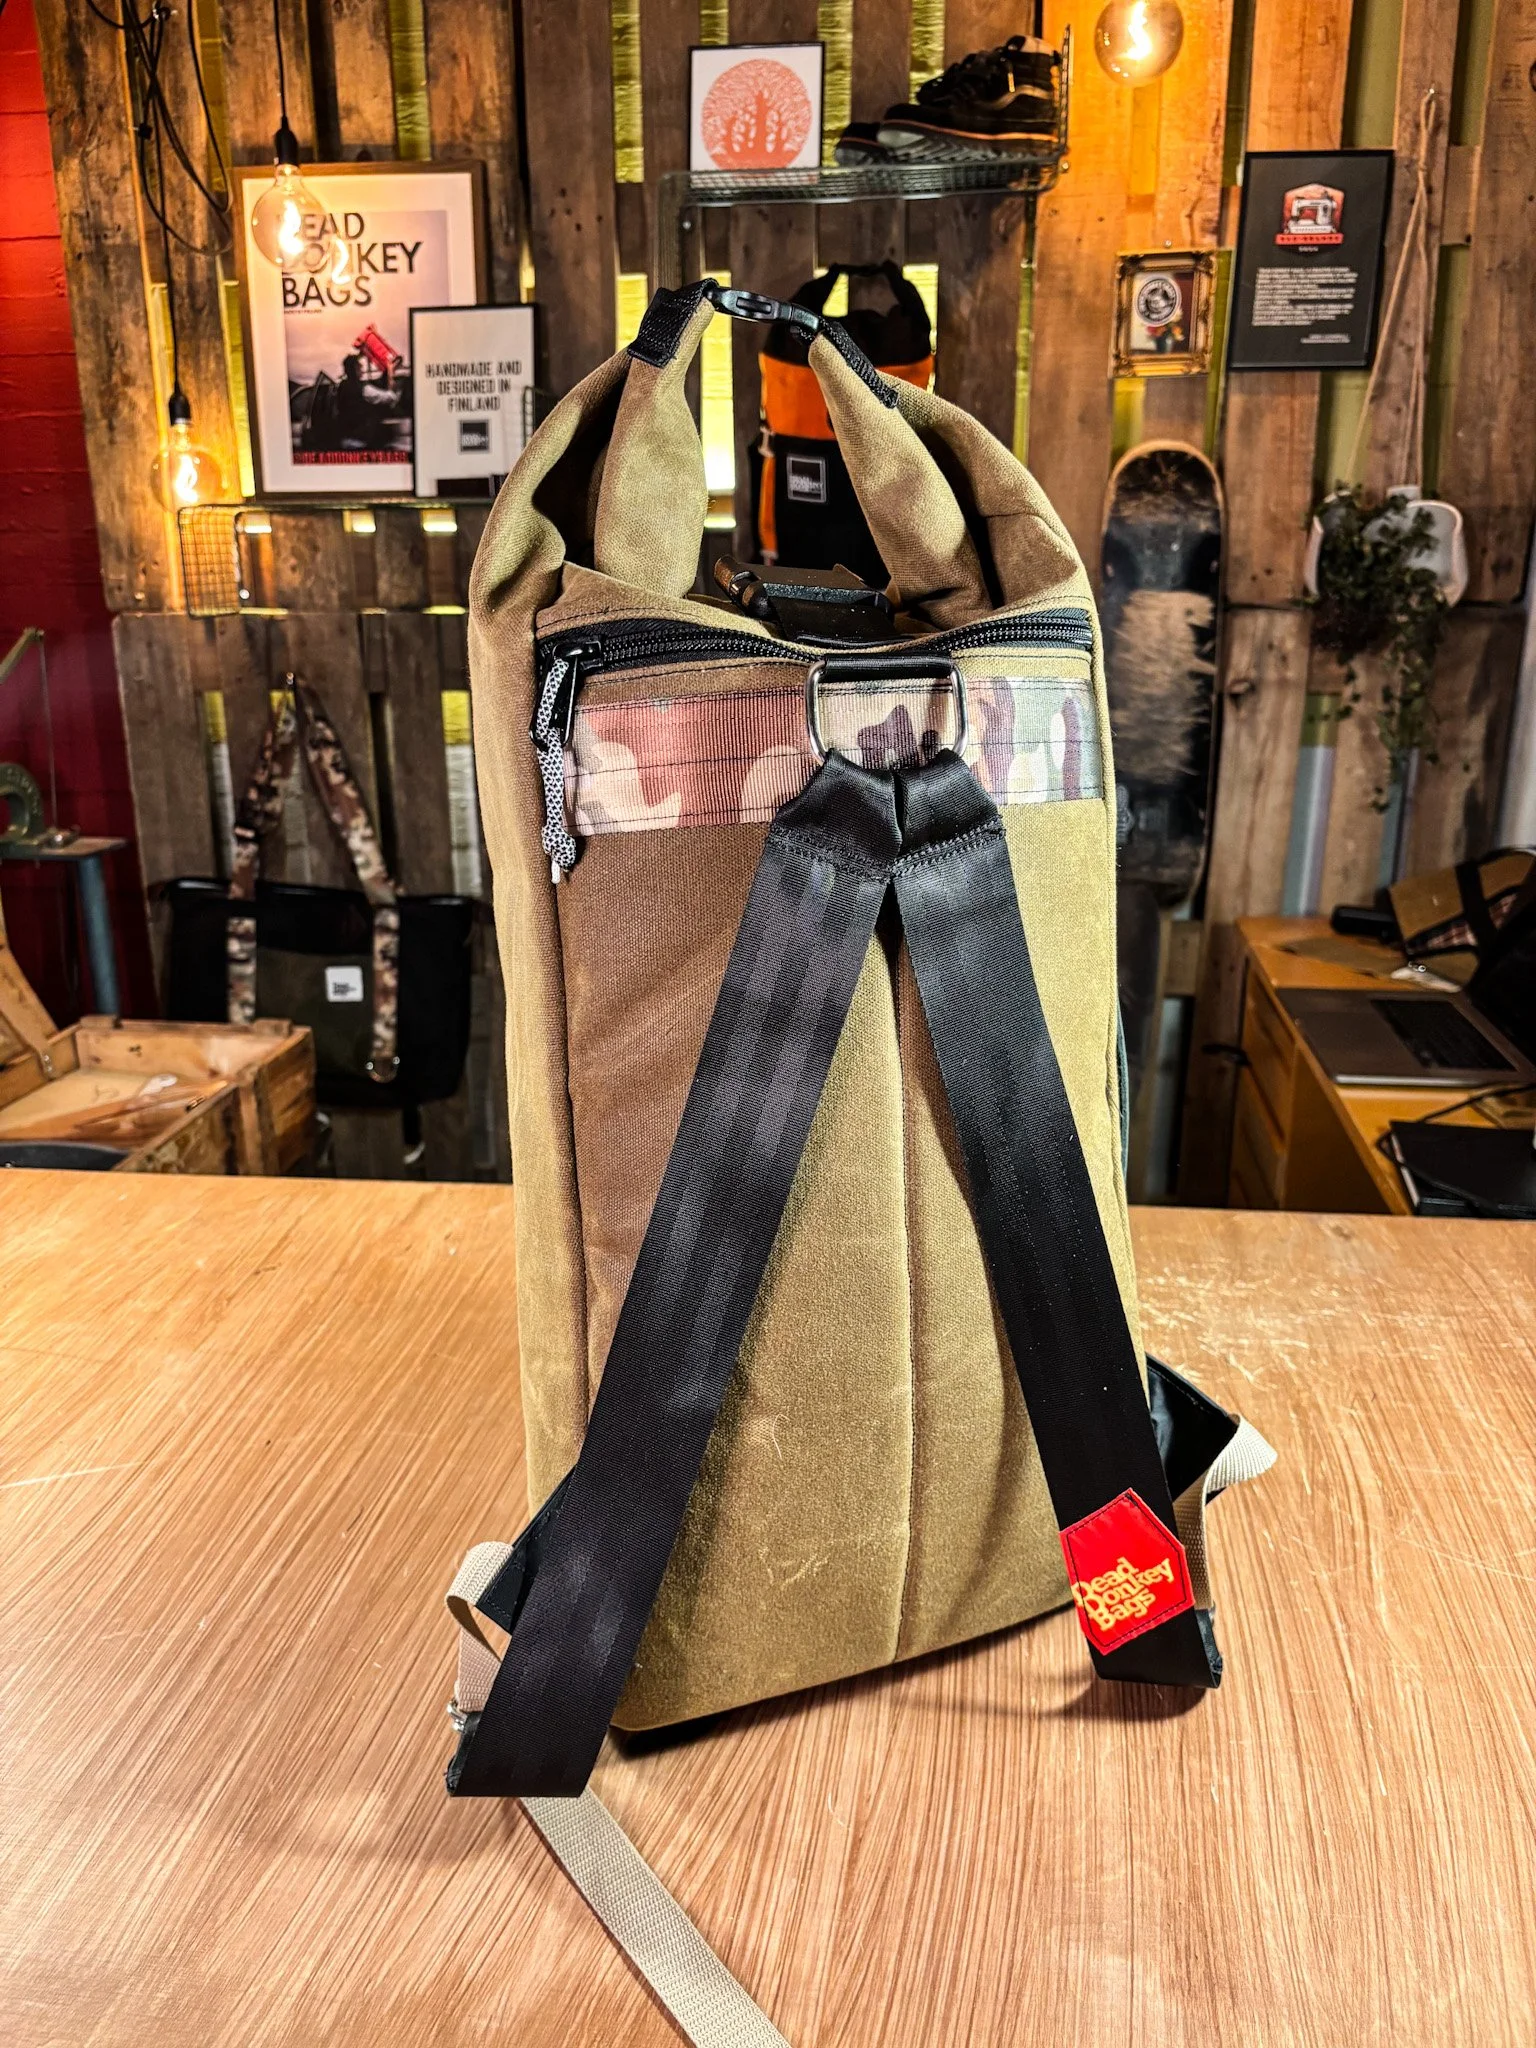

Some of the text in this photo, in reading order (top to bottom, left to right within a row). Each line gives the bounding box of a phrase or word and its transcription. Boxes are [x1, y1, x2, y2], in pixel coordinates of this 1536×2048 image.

[281, 212, 365, 241] EAD
[282, 275, 373, 308] BAGS
[425, 360, 522, 378] HANDMADE AND
[436, 379, 511, 396] DESIGNED IN
[447, 397, 501, 412] FINLAND
[1070, 1556, 1139, 1606] Dead
[1083, 1558, 1174, 1617] Donkey
[1091, 1588, 1156, 1631] Bags
